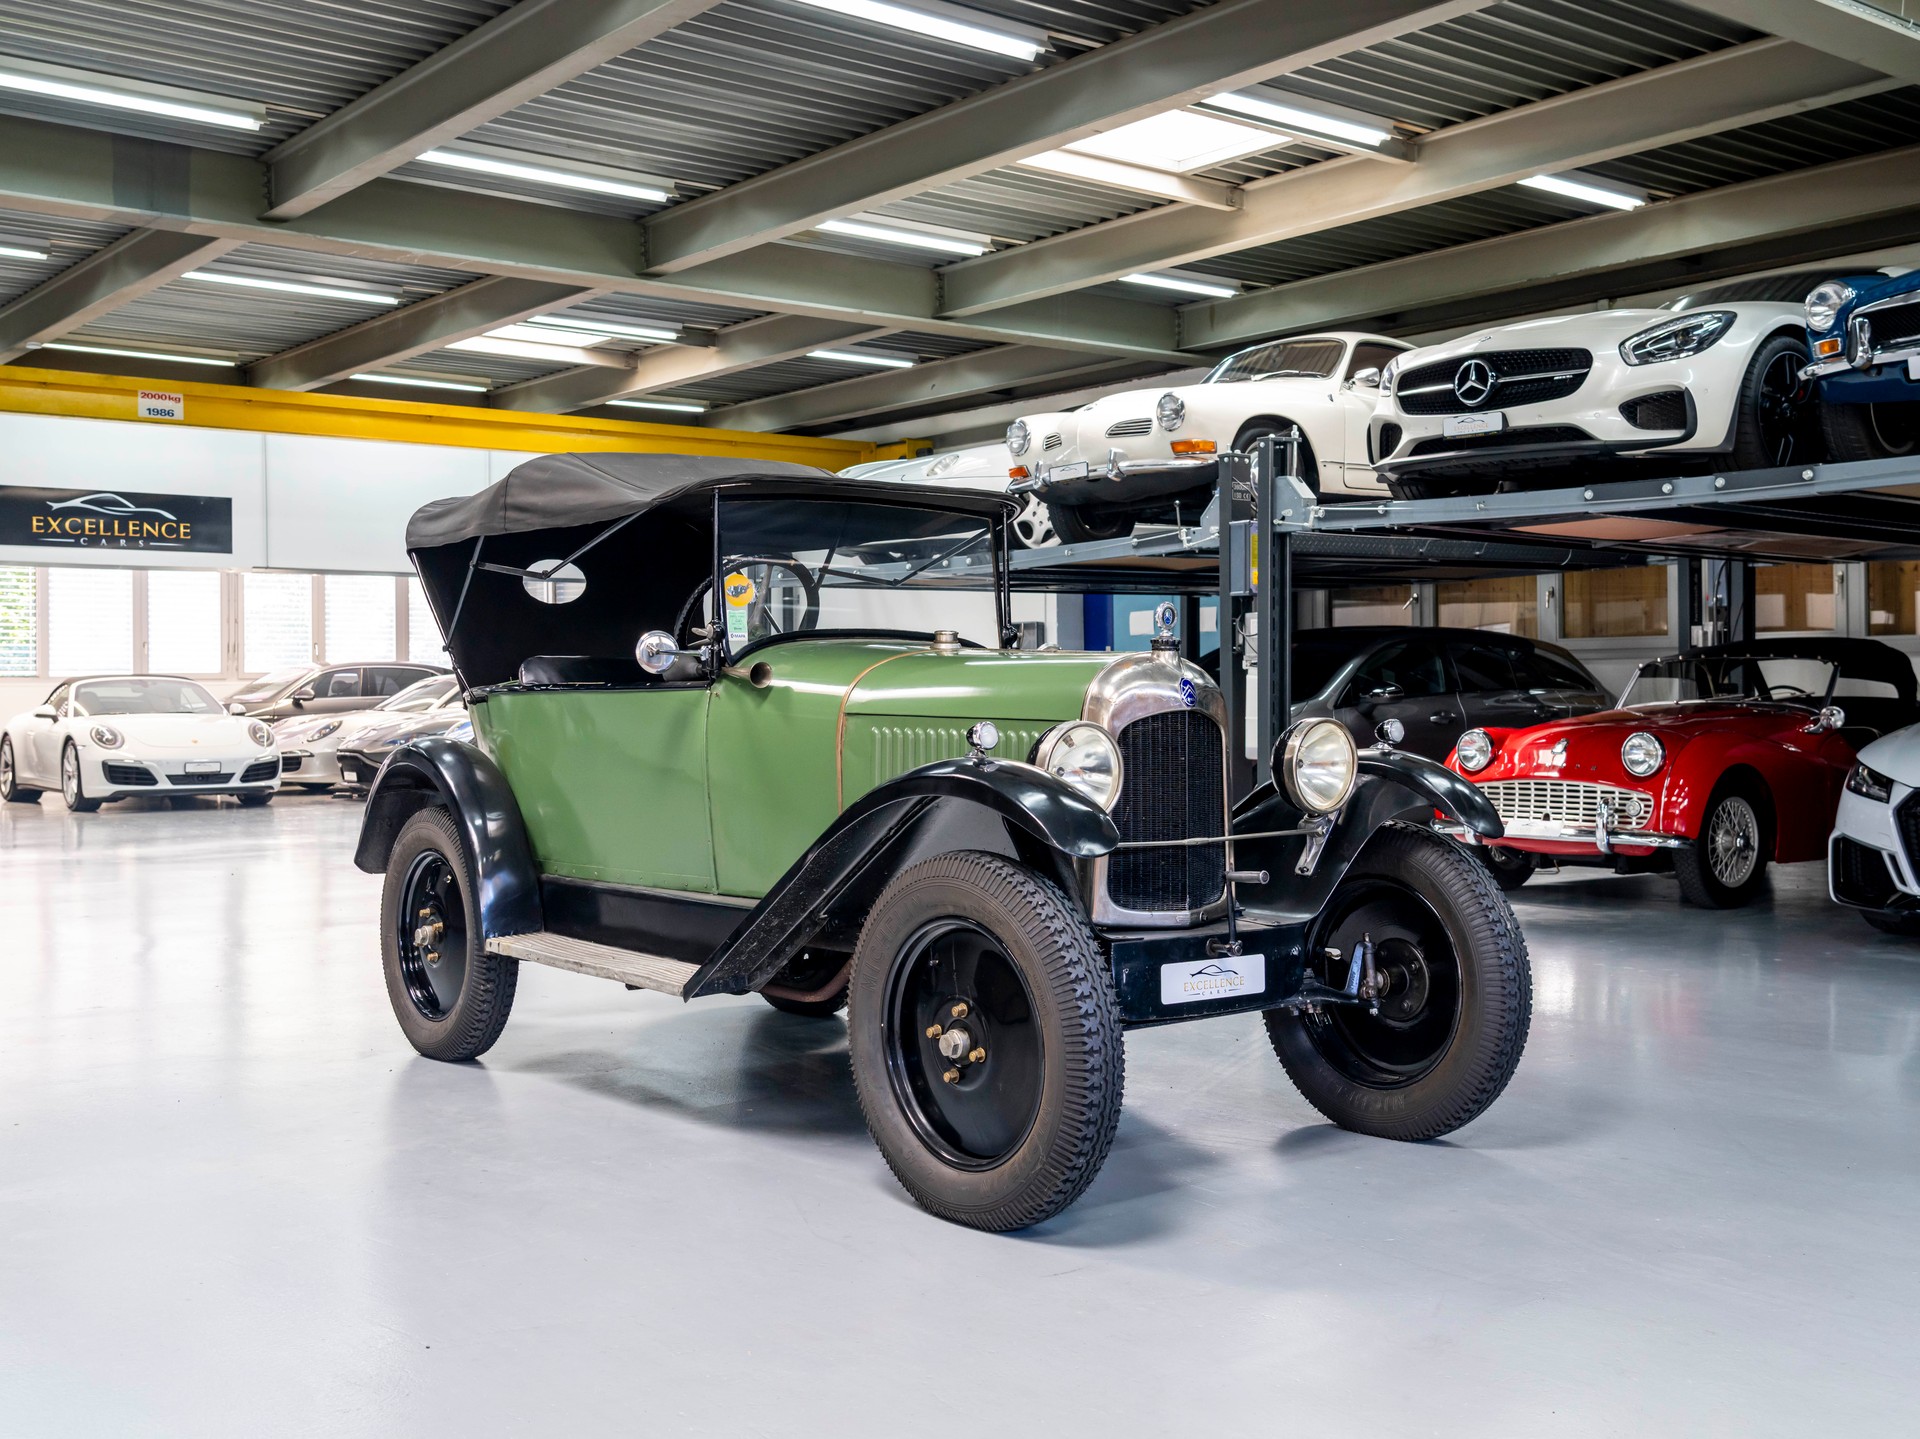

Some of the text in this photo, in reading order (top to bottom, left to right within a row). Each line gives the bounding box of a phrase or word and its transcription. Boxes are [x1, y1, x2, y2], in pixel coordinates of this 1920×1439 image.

[146, 408, 175, 417] 1986
[31, 516, 192, 539] EXCELLENCE
[80, 537, 144, 547] CARS
[1183, 976, 1245, 992] EXCELLENCE
